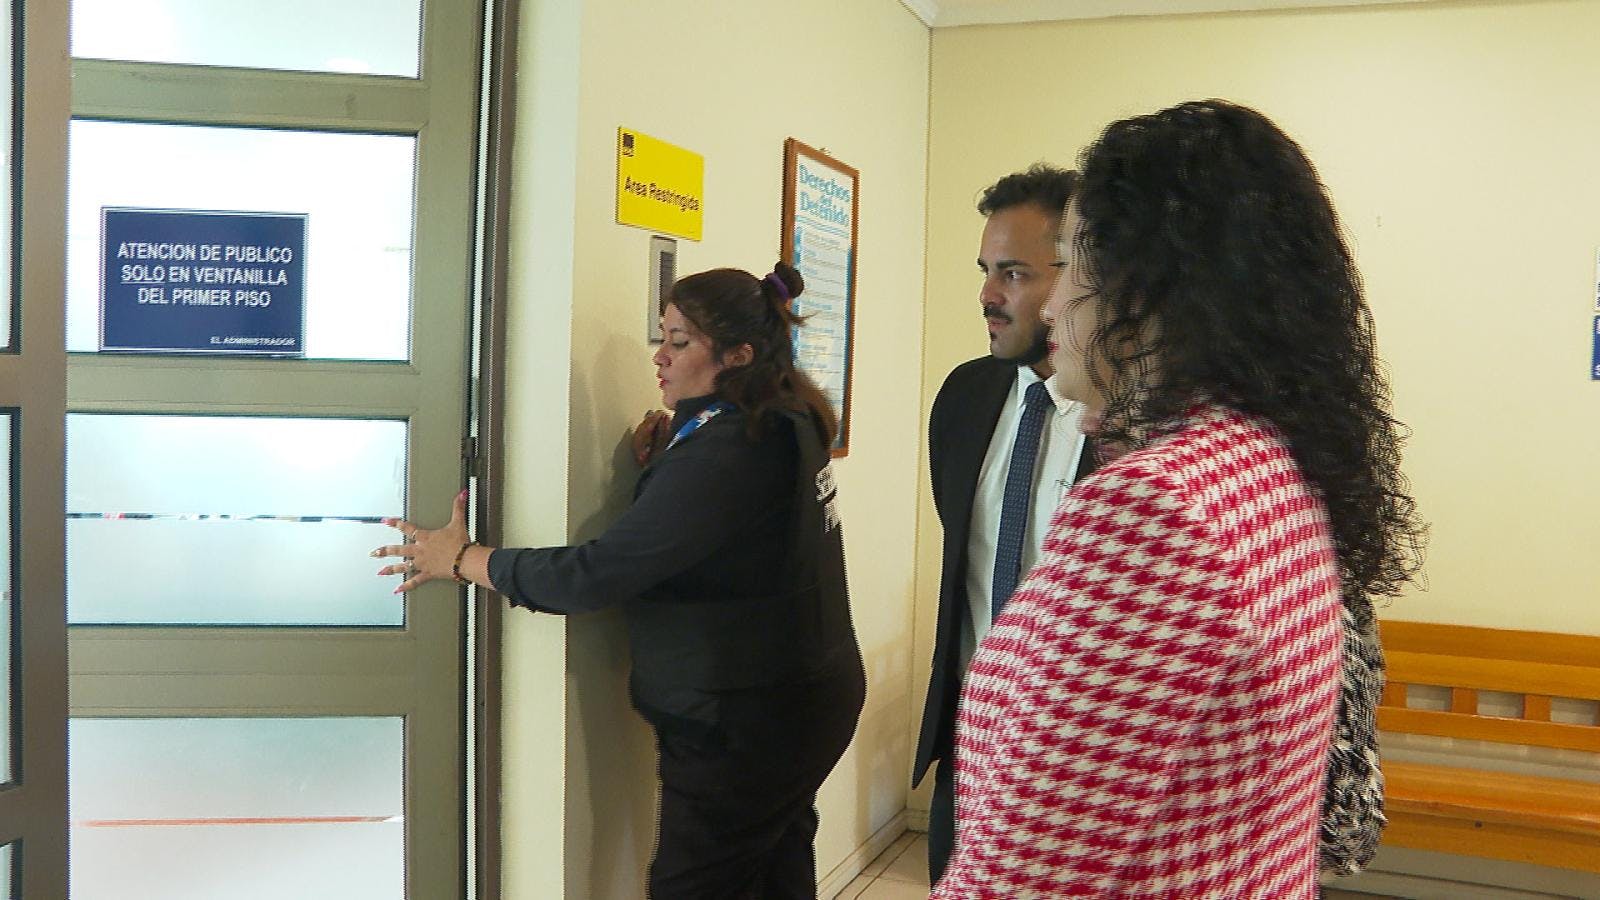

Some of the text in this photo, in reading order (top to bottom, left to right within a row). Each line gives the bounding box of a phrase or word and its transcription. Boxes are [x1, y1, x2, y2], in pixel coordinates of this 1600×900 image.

[799, 164, 850, 202] Derechos
[649, 183, 699, 212] Restringida
[800, 191, 850, 227] Detenido
[117, 242, 293, 263] ATENCION DE PUBLICO
[121, 264, 288, 285] SOLO EN VENTANILLA
[137, 287, 271, 308] DEL PRIMER PISO
[210, 335, 296, 346] EL ADMINISTRADOR
